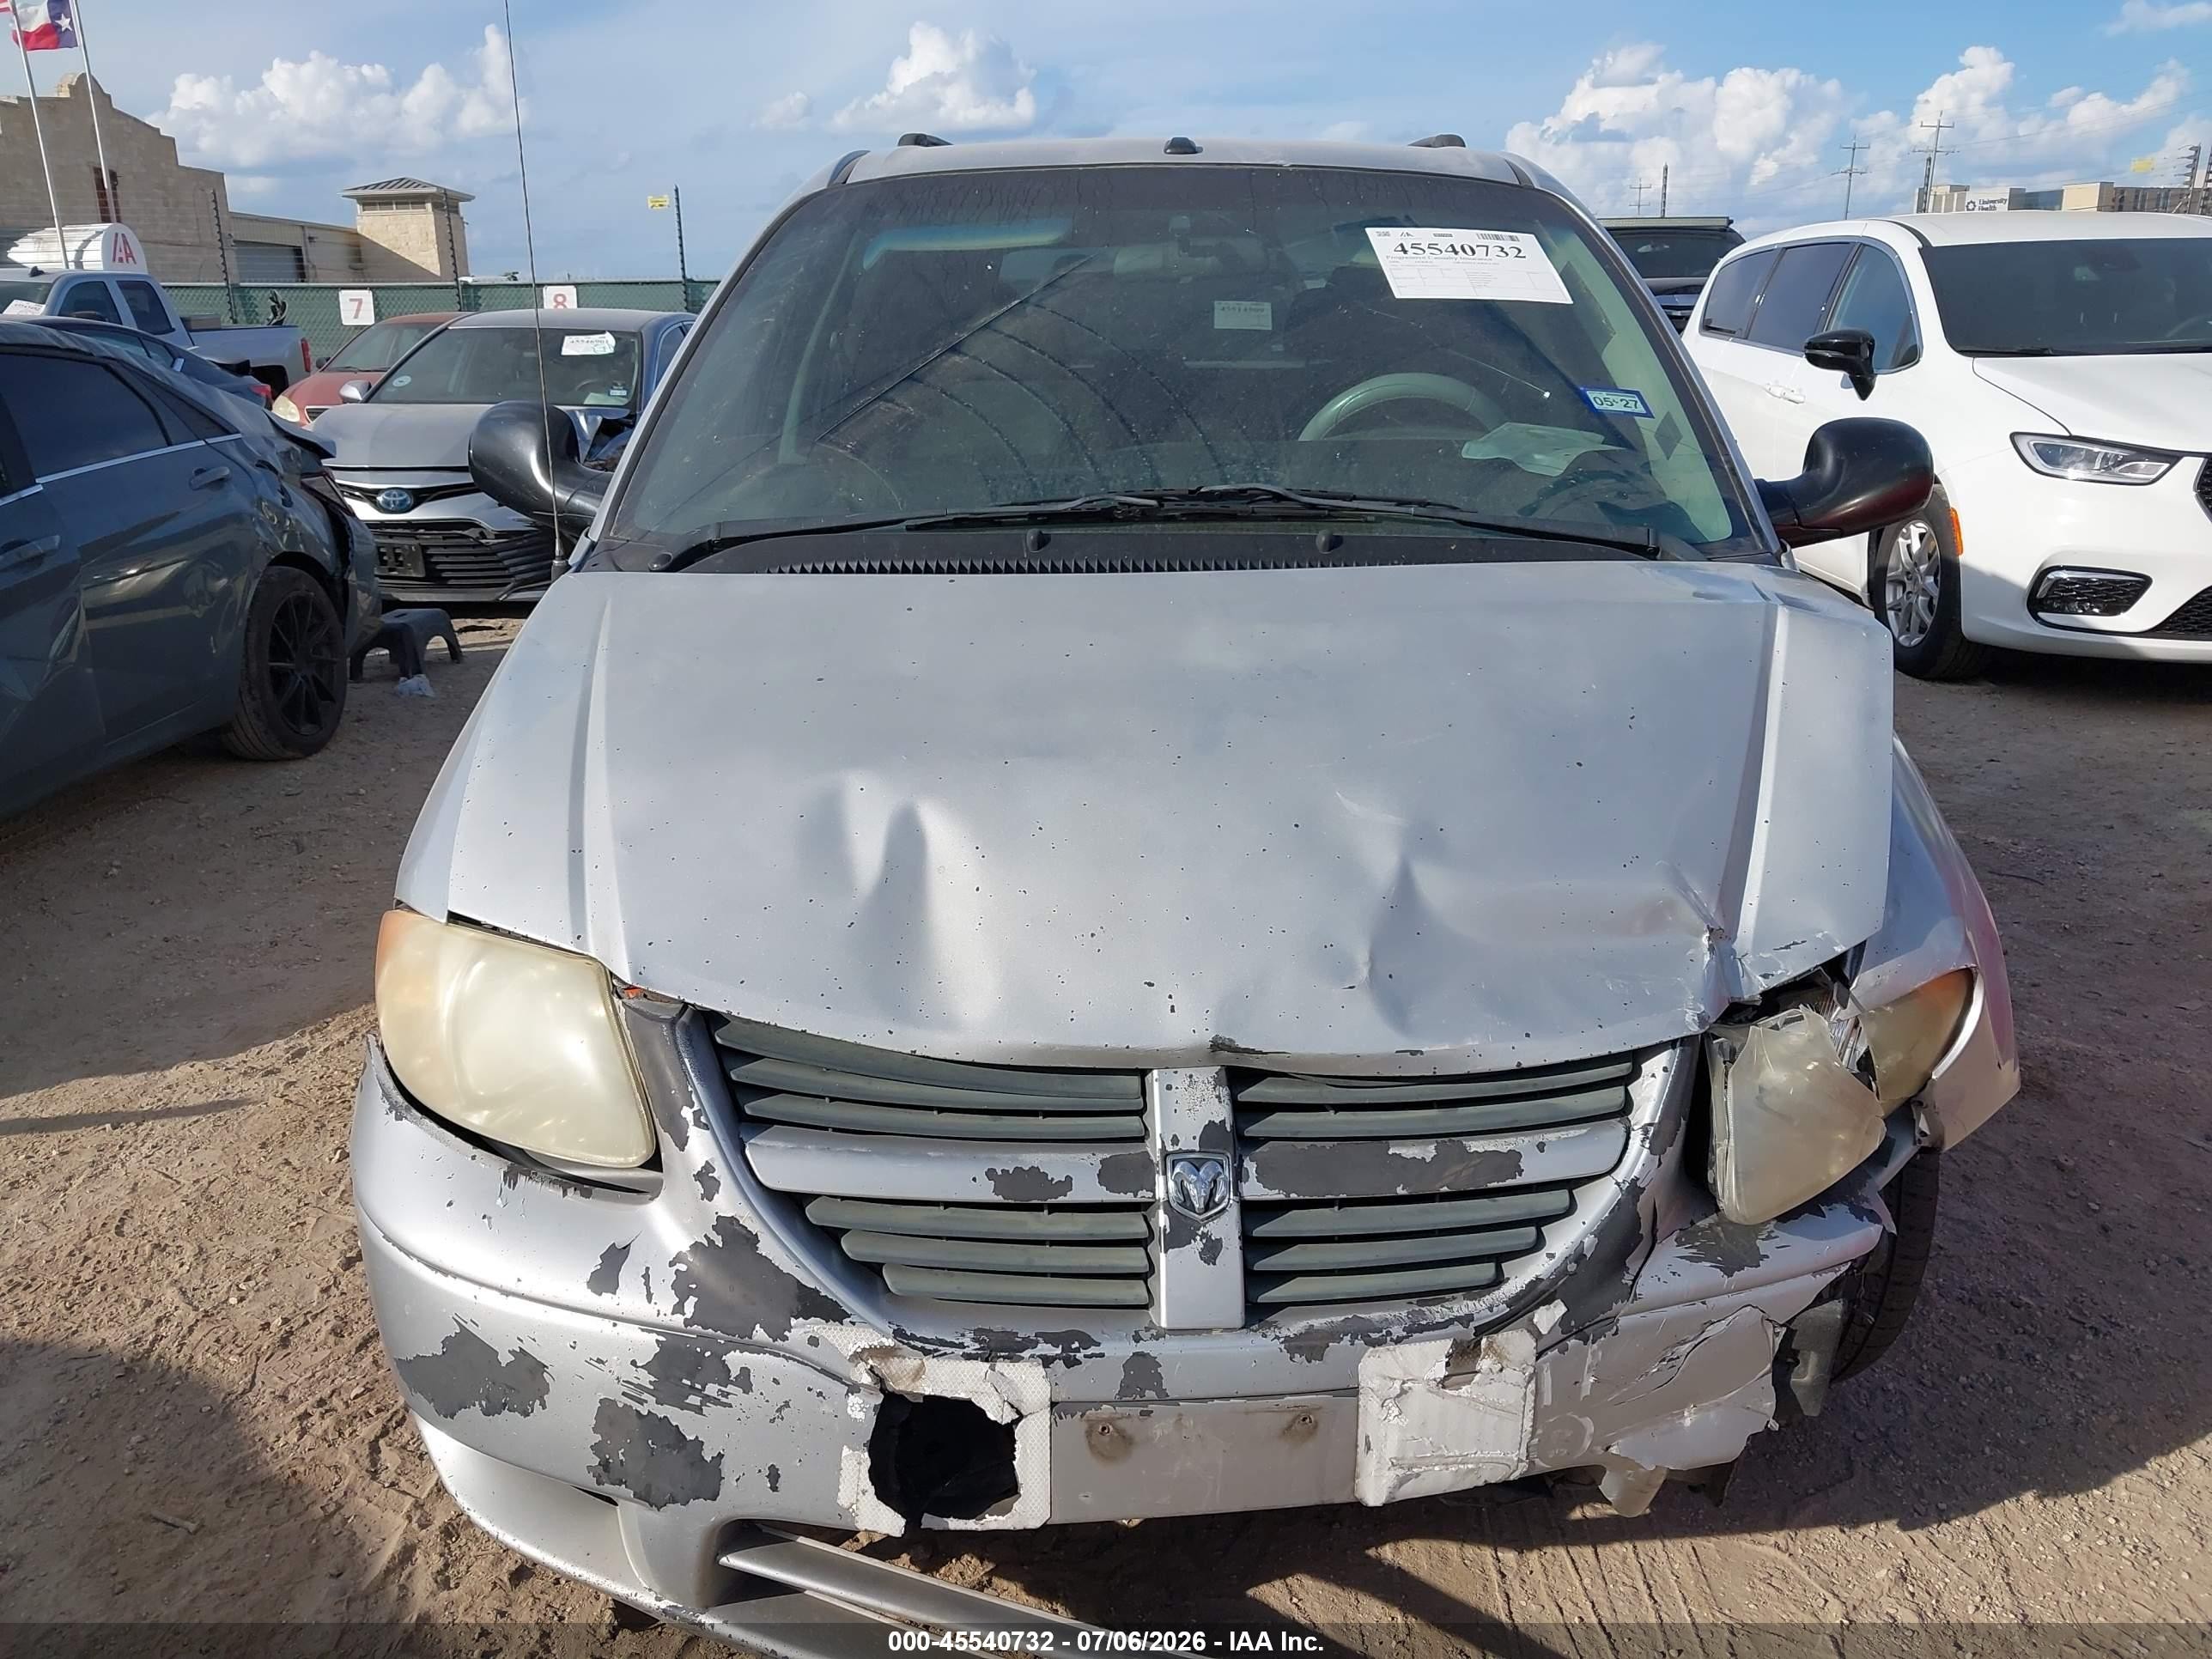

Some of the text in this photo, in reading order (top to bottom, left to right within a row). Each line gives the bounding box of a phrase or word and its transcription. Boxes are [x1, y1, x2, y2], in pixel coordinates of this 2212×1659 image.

[1394, 242, 1526, 258] 45540732
[349, 298, 363, 319] 7
[553, 293, 567, 308] 8
